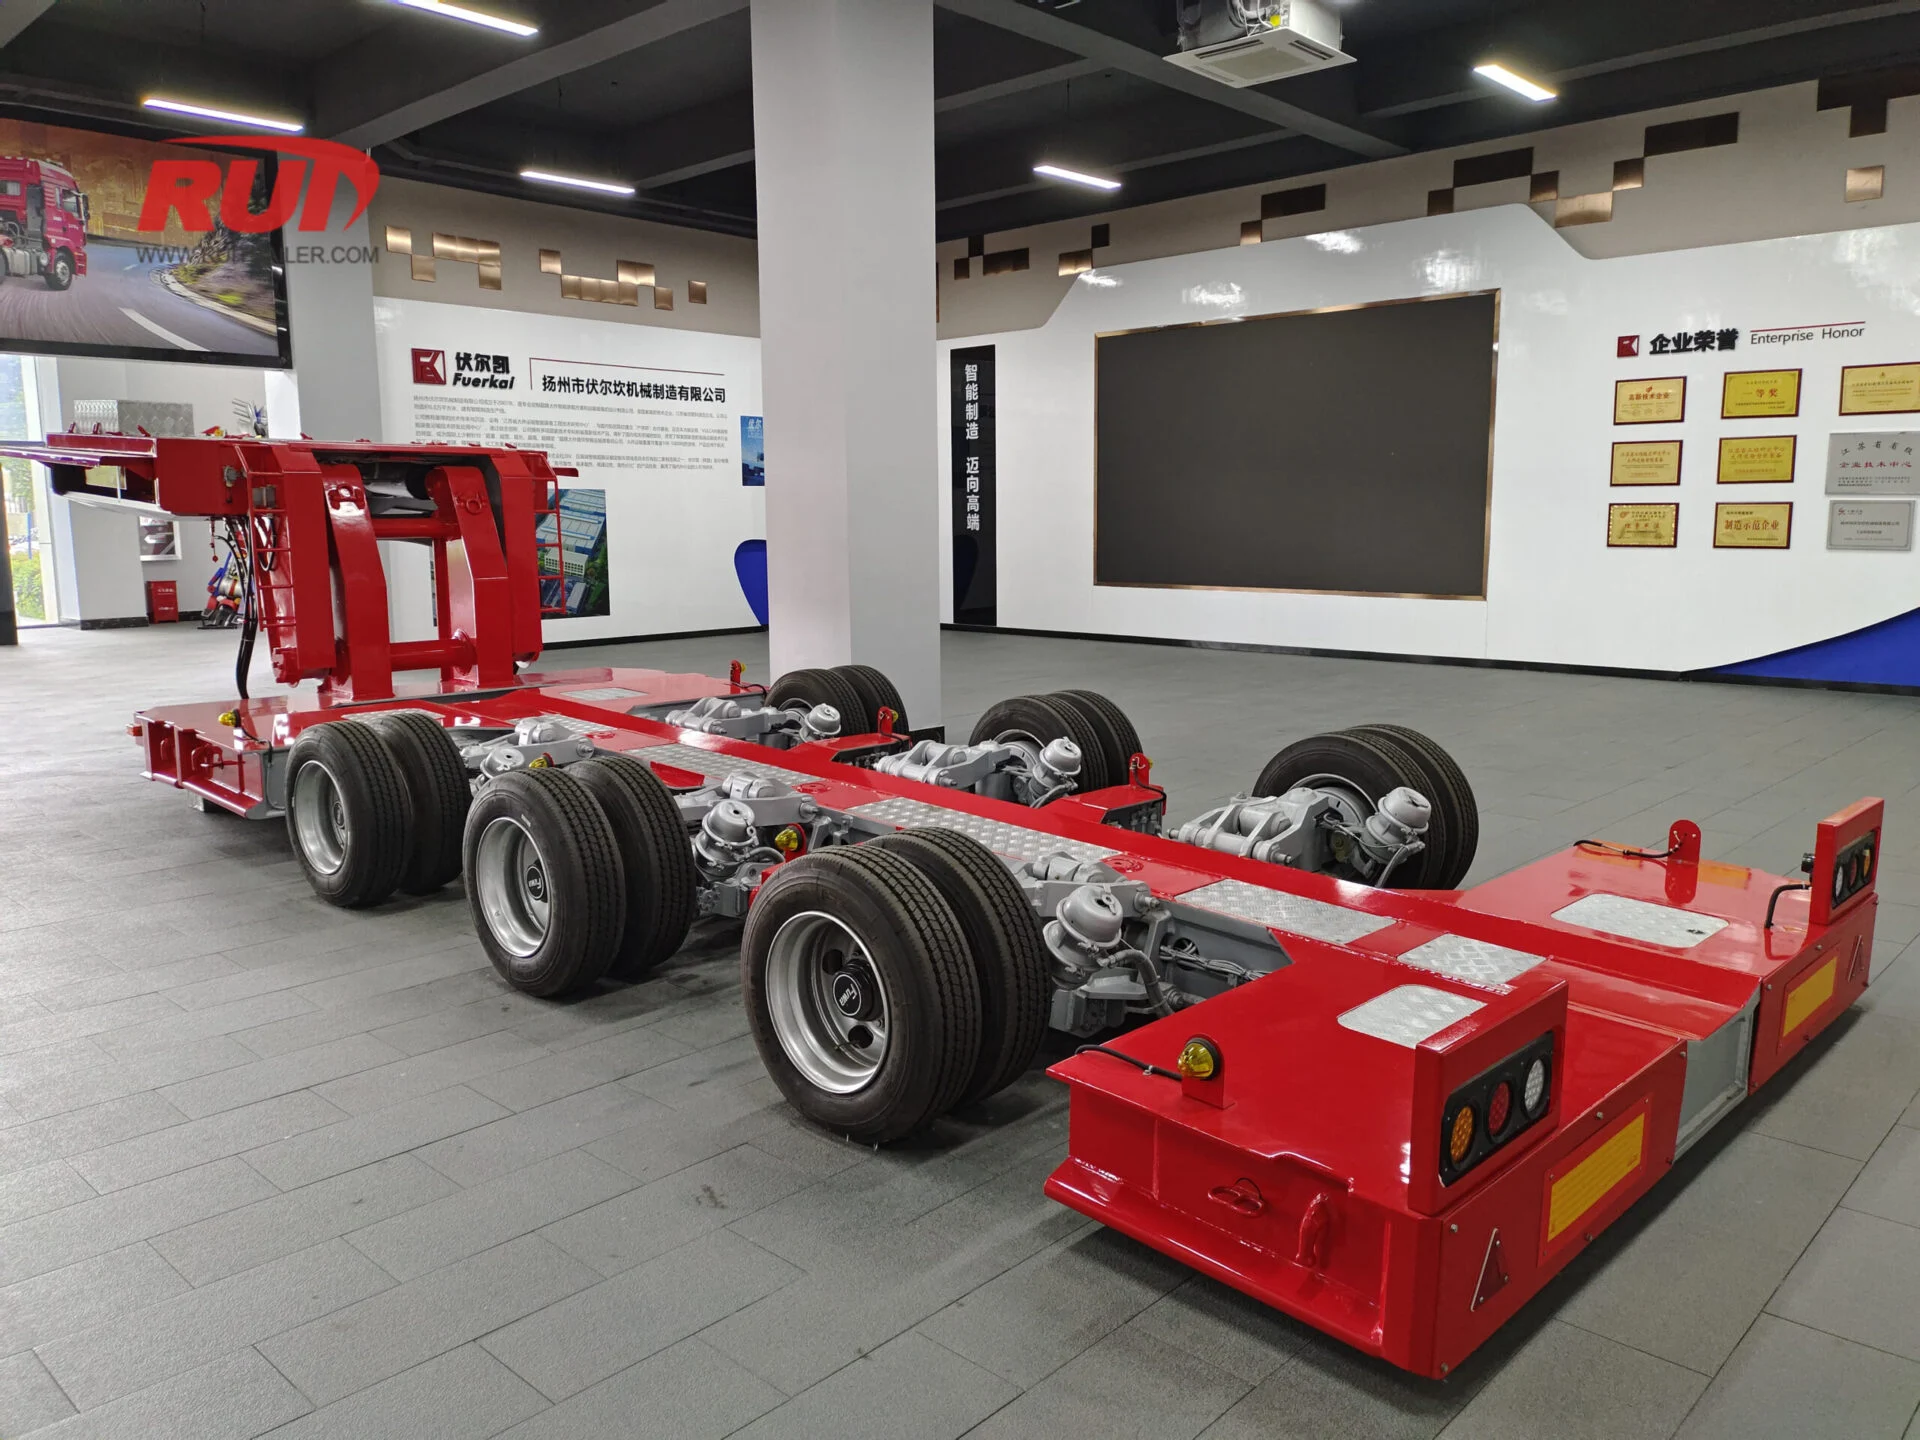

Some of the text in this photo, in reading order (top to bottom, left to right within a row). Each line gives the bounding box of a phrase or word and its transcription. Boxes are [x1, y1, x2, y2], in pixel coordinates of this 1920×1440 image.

[1649, 328, 1739, 355] 企业荣誉
[1750, 326, 1865, 345] Enterprise Honor
[454, 351, 510, 375] 伏尔凯
[452, 372, 515, 391] Fuerkai
[541, 374, 727, 404] 扬州市伏尔坎机械制造有限公司
[964, 363, 980, 532] 智能制造 迈向高端
[1724, 519, 1780, 531] 制造示范企业
